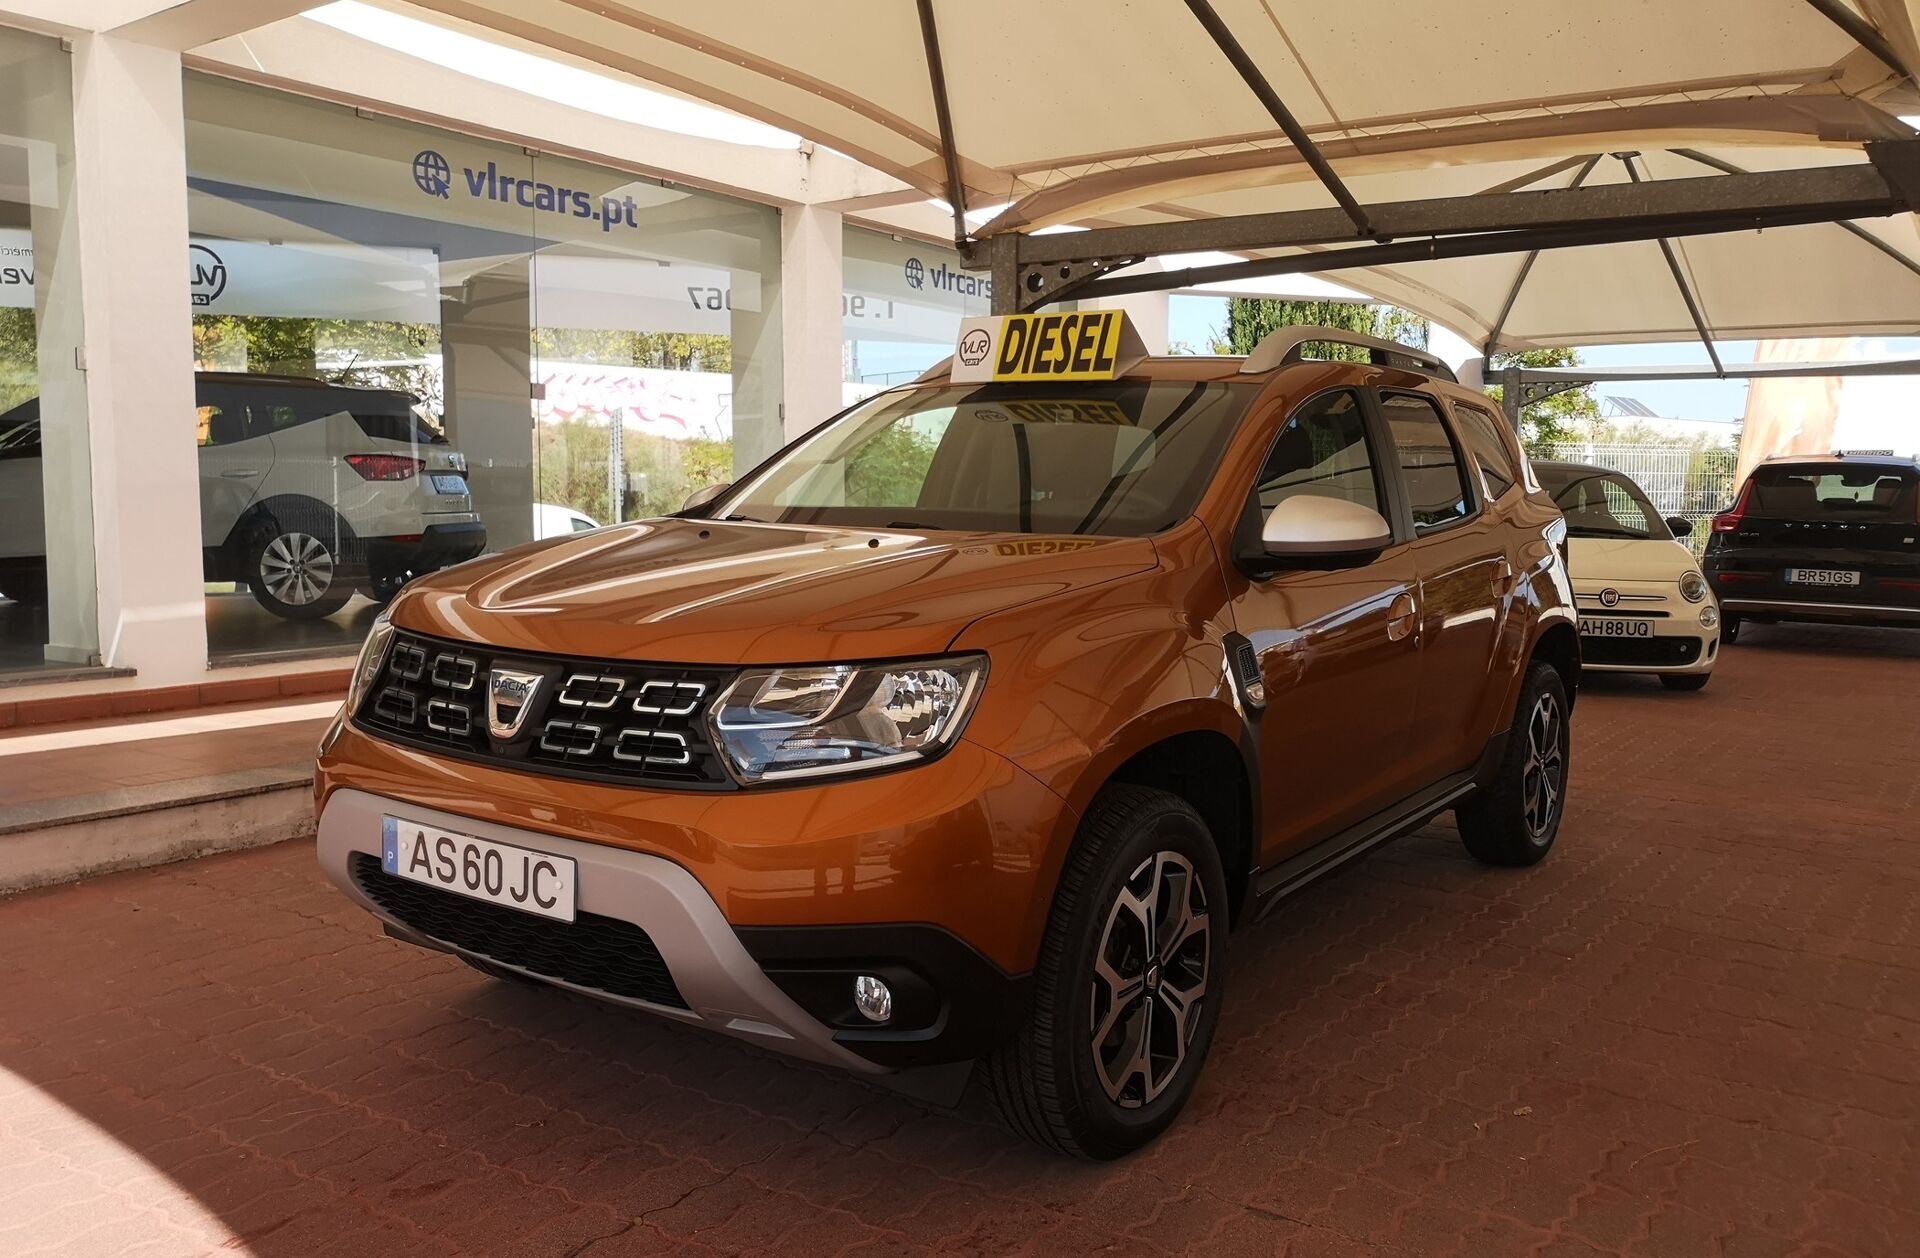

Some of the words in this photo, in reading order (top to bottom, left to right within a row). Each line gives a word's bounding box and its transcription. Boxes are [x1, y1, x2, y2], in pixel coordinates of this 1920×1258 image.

[463, 161, 638, 232] vlrcars.pt
[960, 340, 988, 354] VLR
[998, 313, 1113, 375] DIESEL
[494, 679, 527, 692] DACIA
